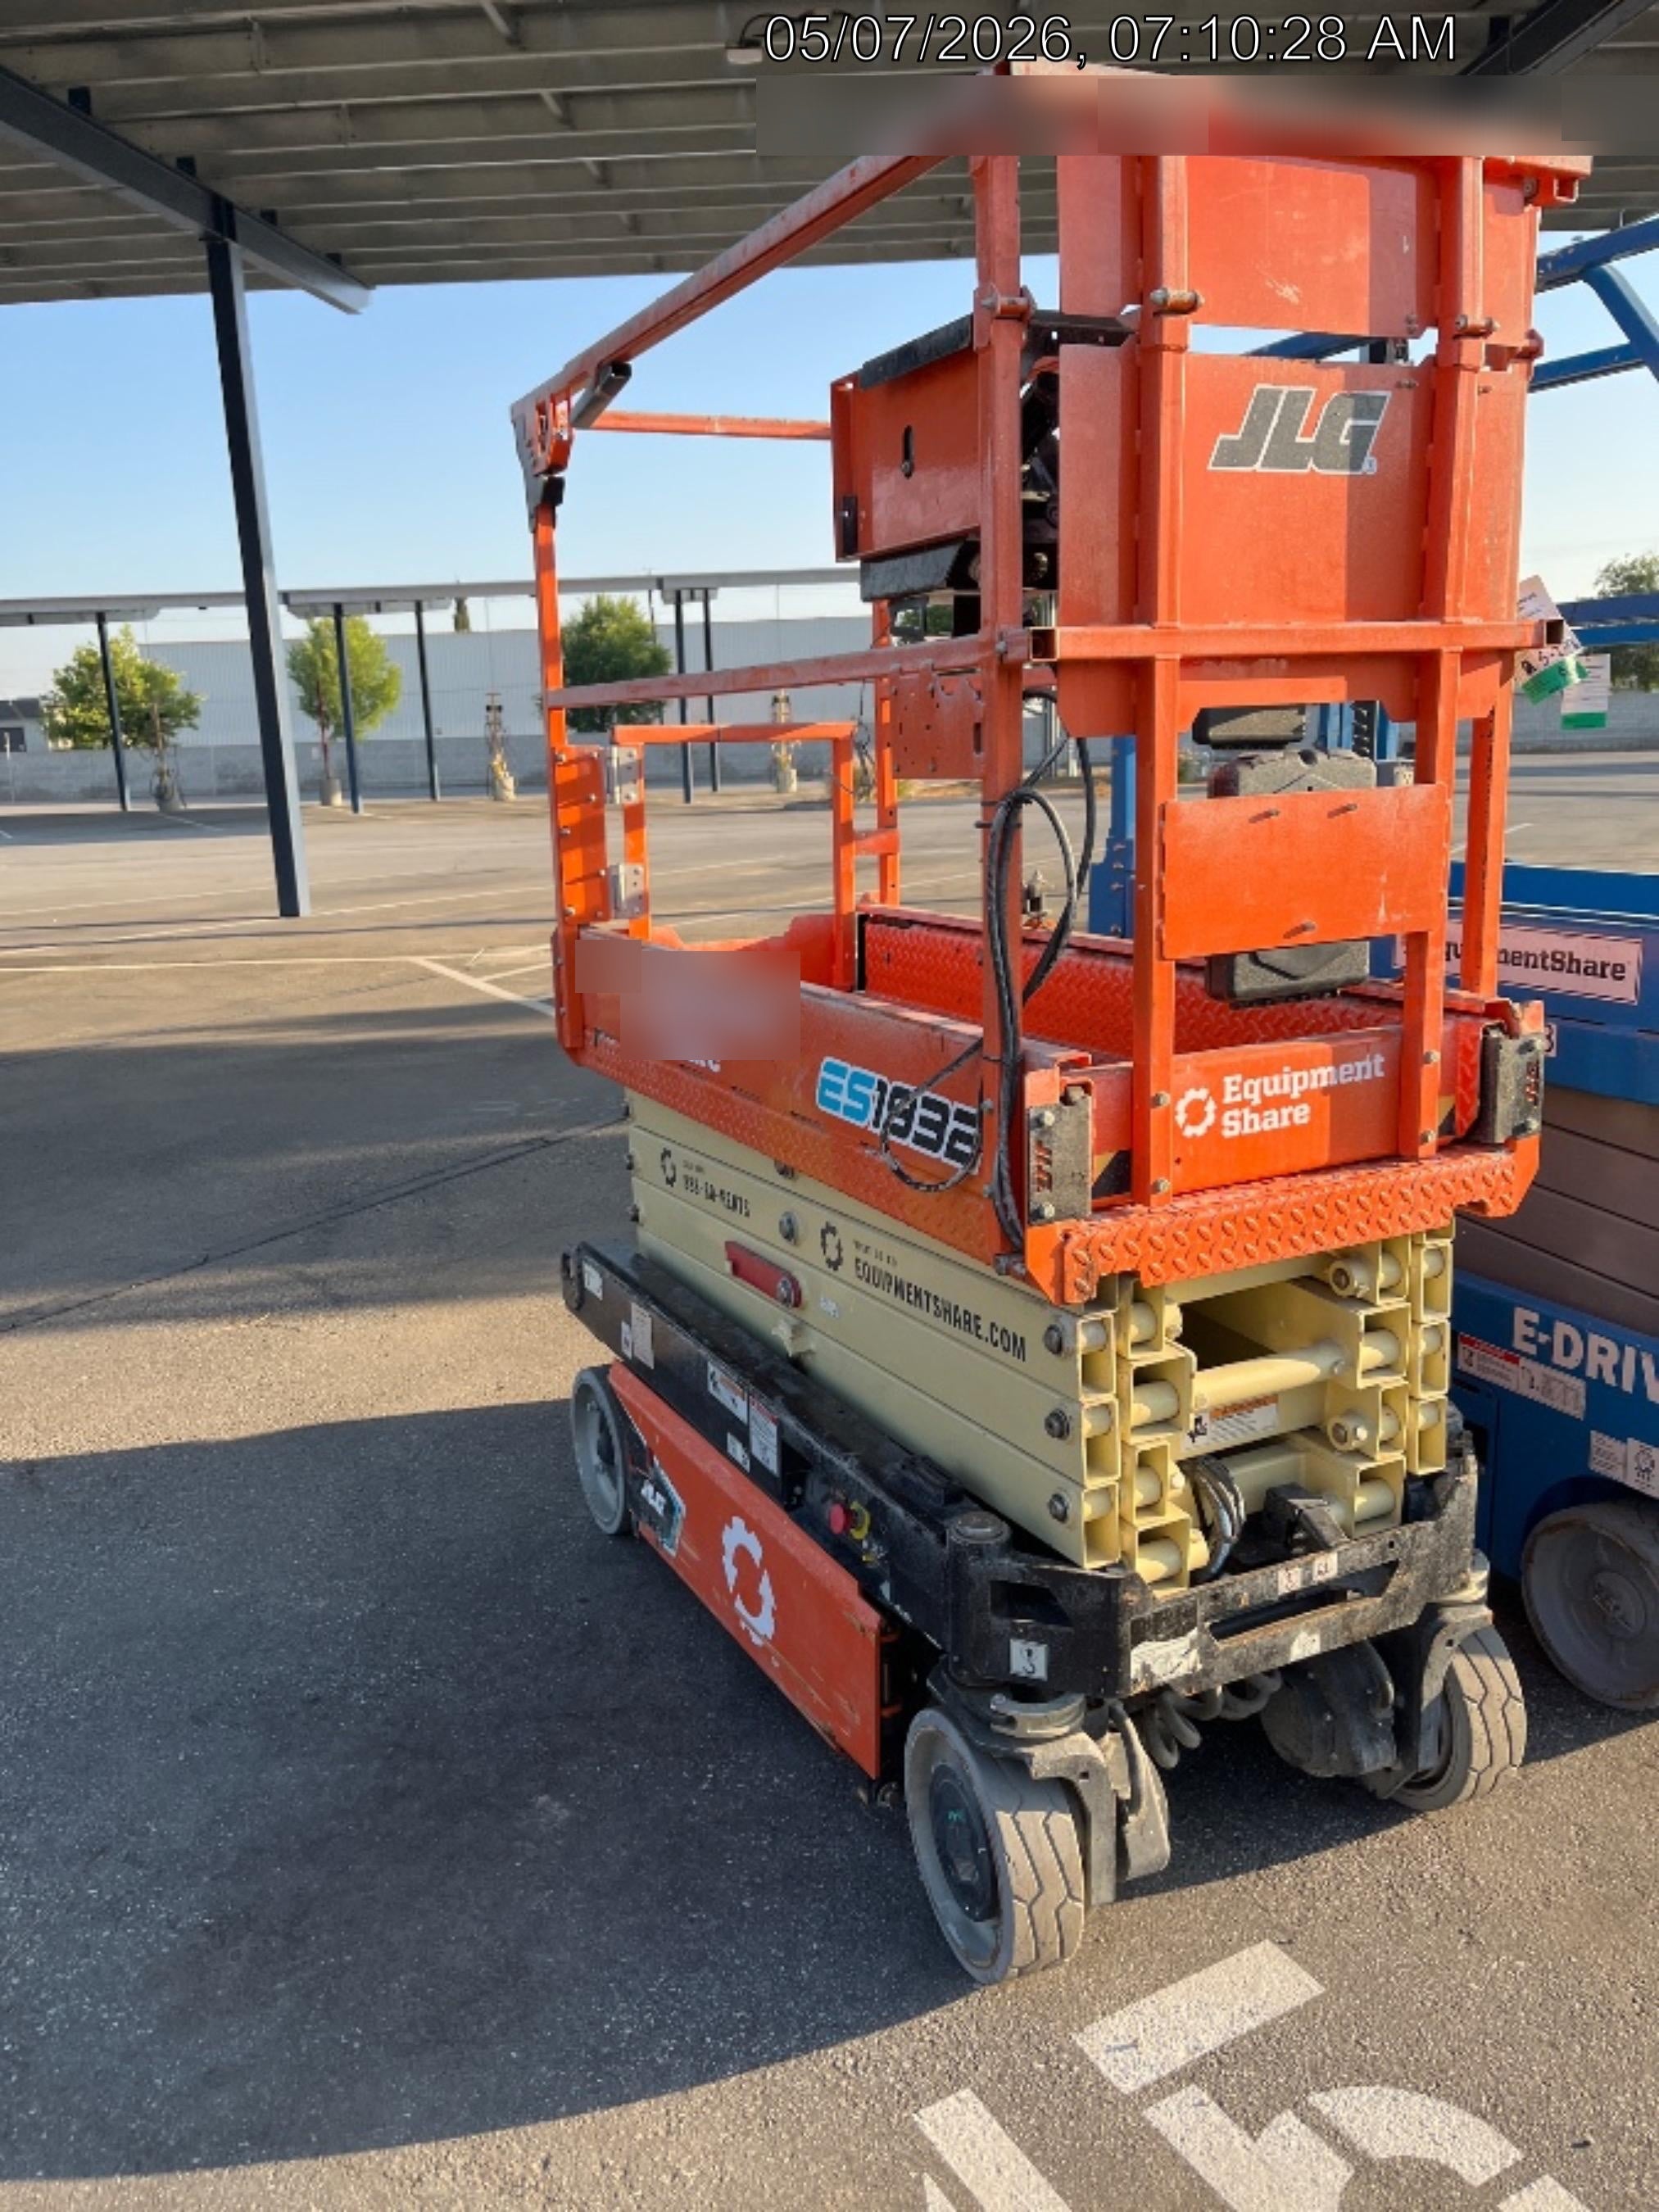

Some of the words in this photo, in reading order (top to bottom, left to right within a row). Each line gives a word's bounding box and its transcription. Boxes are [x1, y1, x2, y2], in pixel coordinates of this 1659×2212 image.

[1208, 383, 1392, 475] JLG
[1222, 1053, 1385, 1106] Equipment
[1221, 1102, 1312, 1140] Share
[854, 1258, 1027, 1362] EQUIPMENTSHARE.COM
